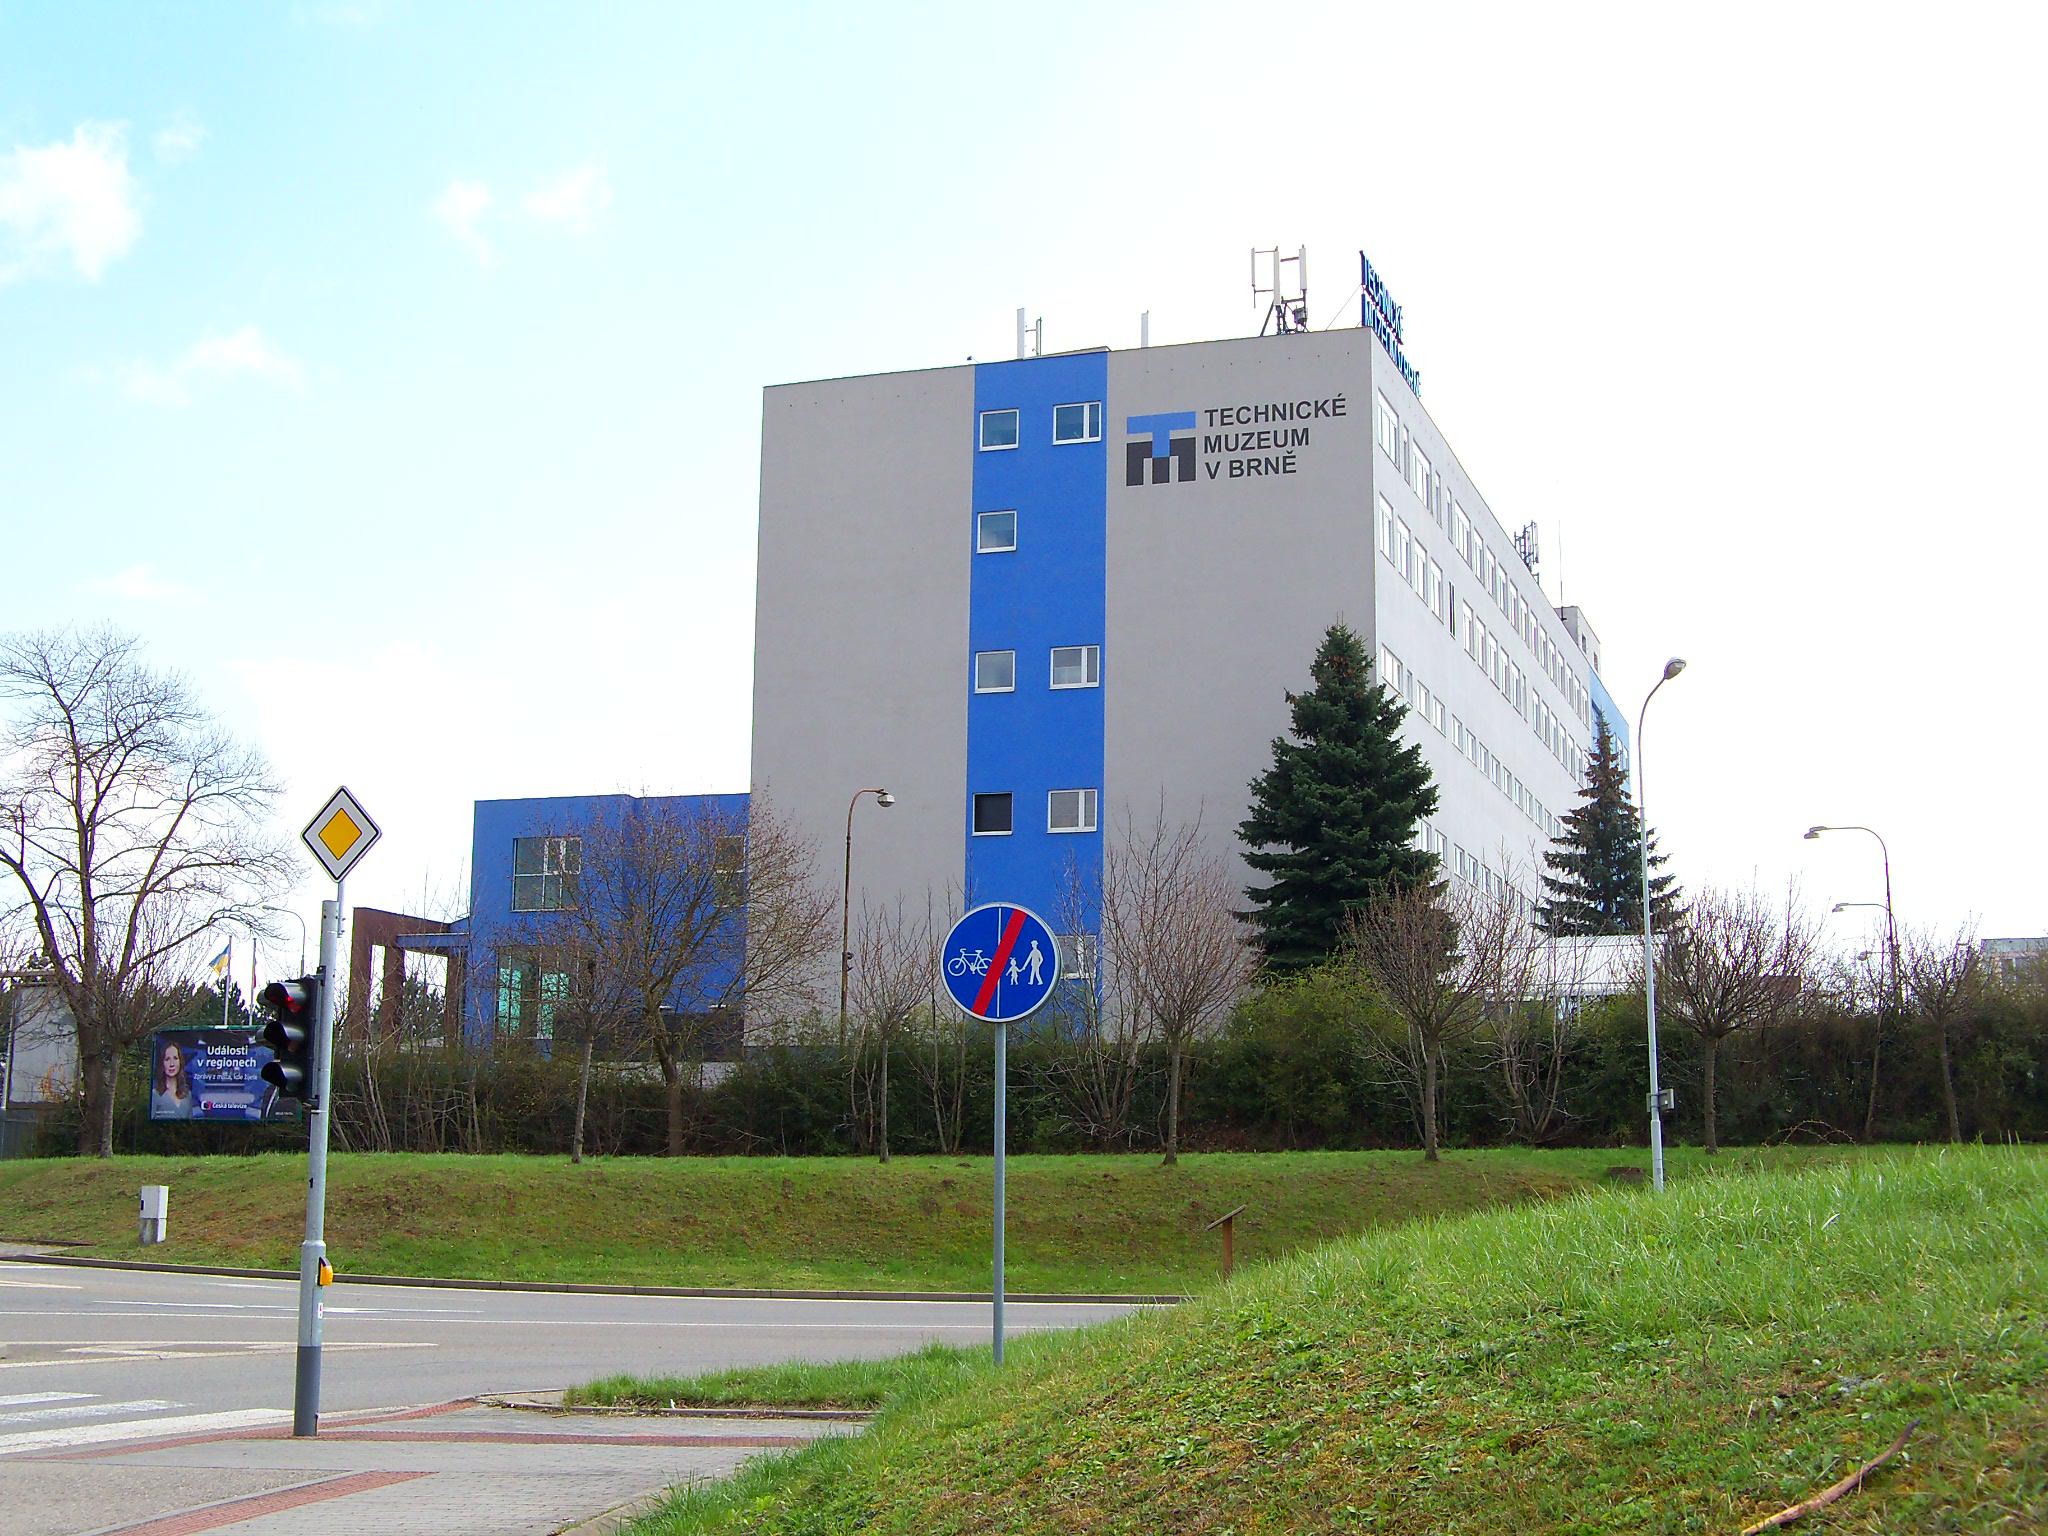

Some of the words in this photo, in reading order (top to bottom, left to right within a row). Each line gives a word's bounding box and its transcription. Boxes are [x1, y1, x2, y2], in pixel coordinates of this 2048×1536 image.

[1204, 393, 1347, 427] TECHNICKÉ
[1204, 427, 1310, 454] MUZEUM
[1205, 461, 1221, 479] V
[1229, 451, 1297, 479] BRNĚ
[206, 1057, 257, 1070] regionech
[207, 1045, 249, 1056] Události
